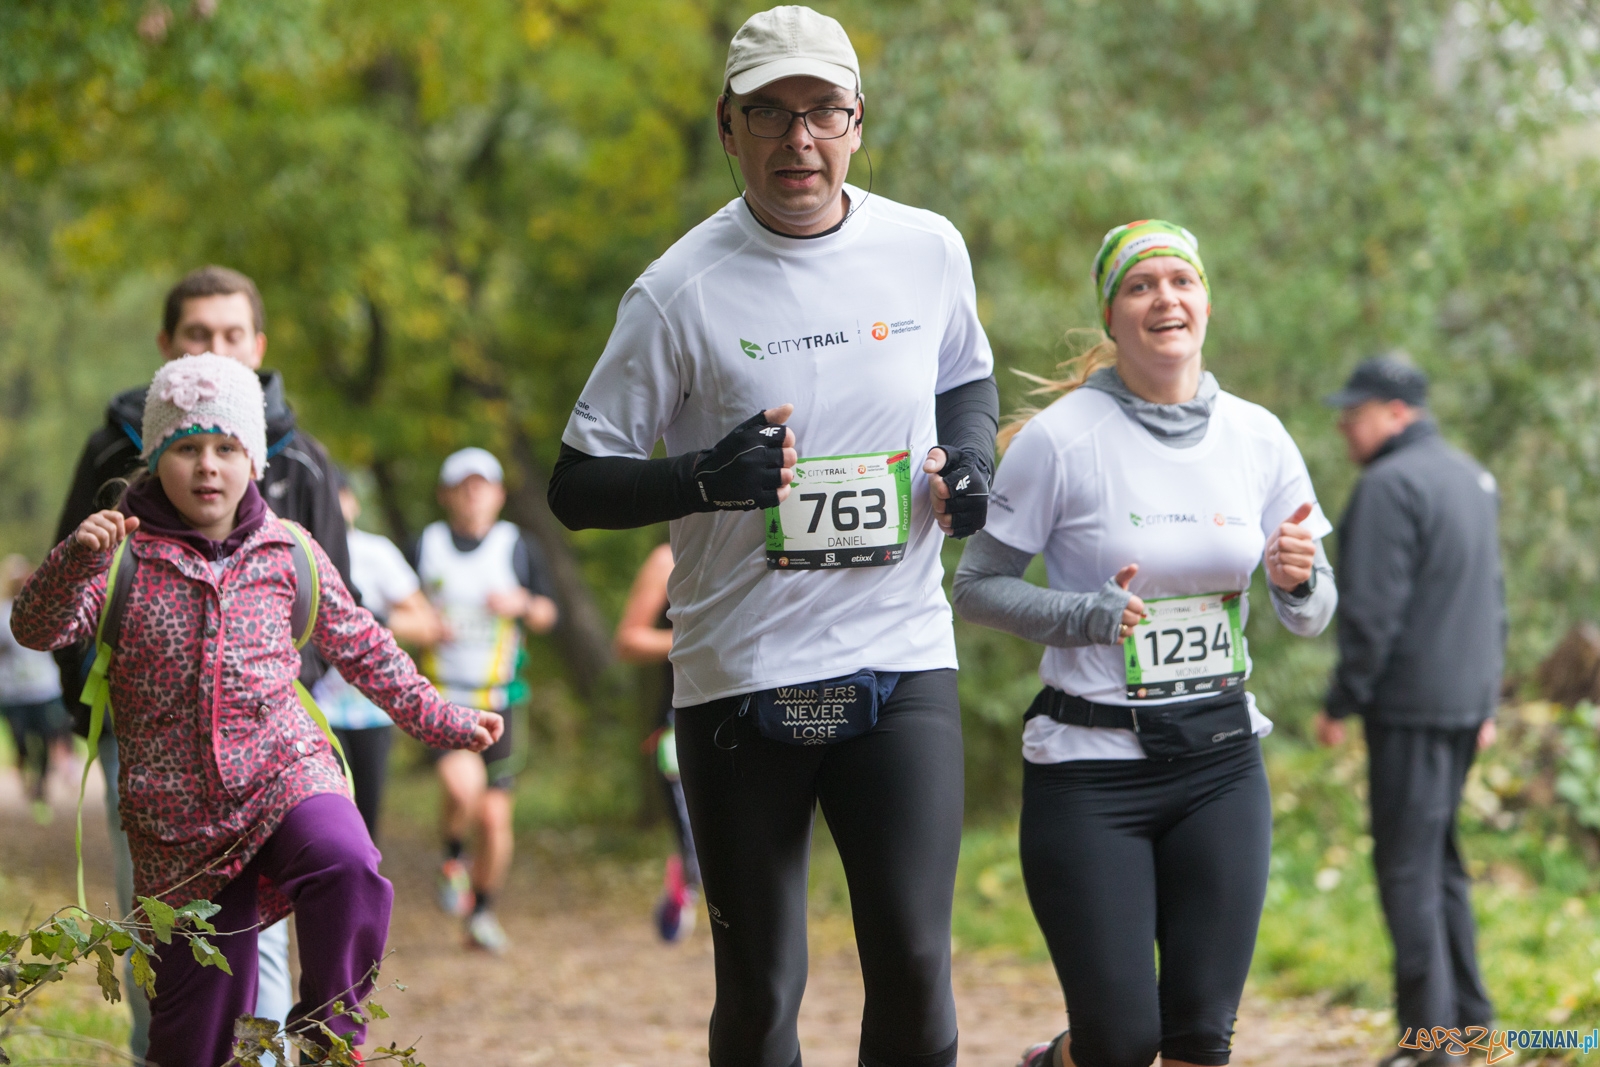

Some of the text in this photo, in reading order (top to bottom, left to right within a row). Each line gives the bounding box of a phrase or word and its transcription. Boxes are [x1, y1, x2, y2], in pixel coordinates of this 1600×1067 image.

[890, 319, 915, 328] nationale
[759, 427, 781, 437] 4F
[955, 475, 971, 491] 4F
[800, 488, 887, 533] 763
[901, 494, 909, 530] Poznań
[828, 536, 866, 547] DANIEL
[1144, 623, 1230, 666] 1234
[786, 704, 845, 719] NEVER
[793, 725, 837, 739] LOSE
